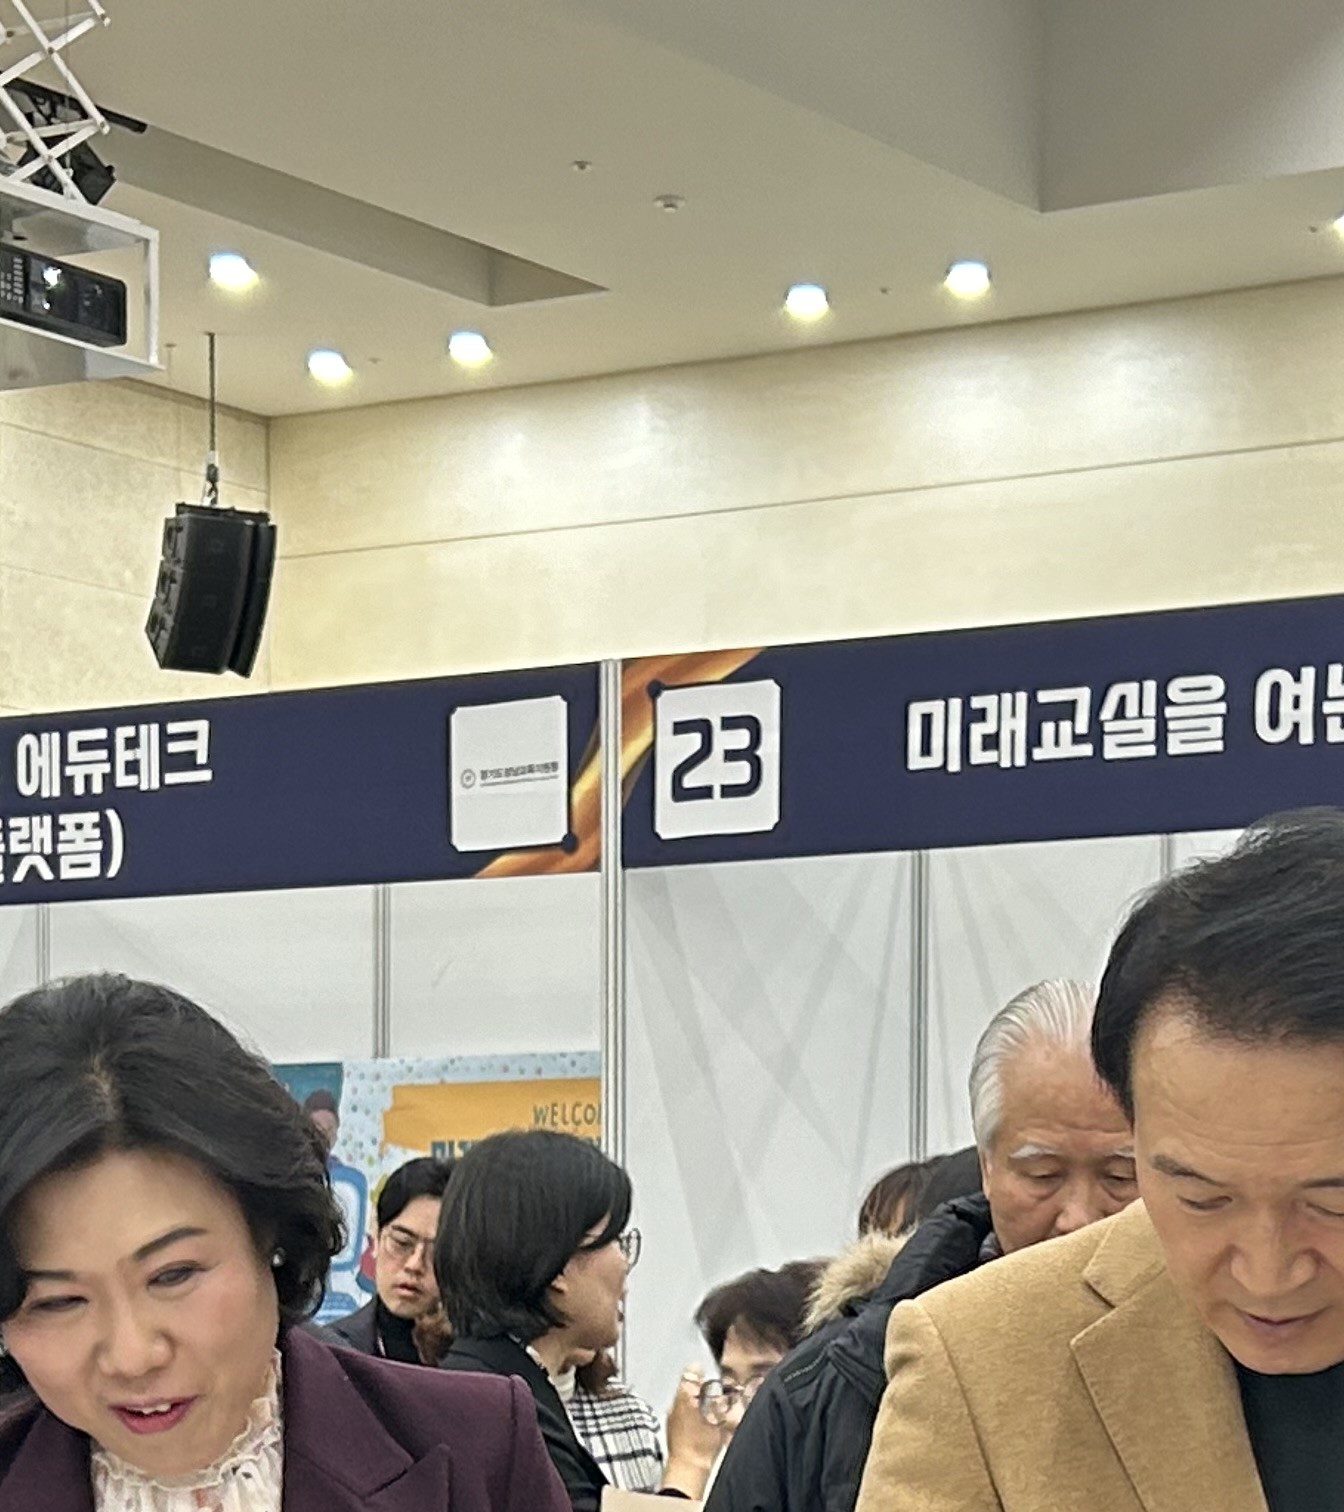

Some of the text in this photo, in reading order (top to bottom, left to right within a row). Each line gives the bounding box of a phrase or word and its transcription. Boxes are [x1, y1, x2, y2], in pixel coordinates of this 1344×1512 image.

[16, 719, 214, 799] 에듀테크
[670, 713, 764, 803] 23
[905, 673, 1229, 773] 미래교실을
[533, 1102, 600, 1127] WELCO
